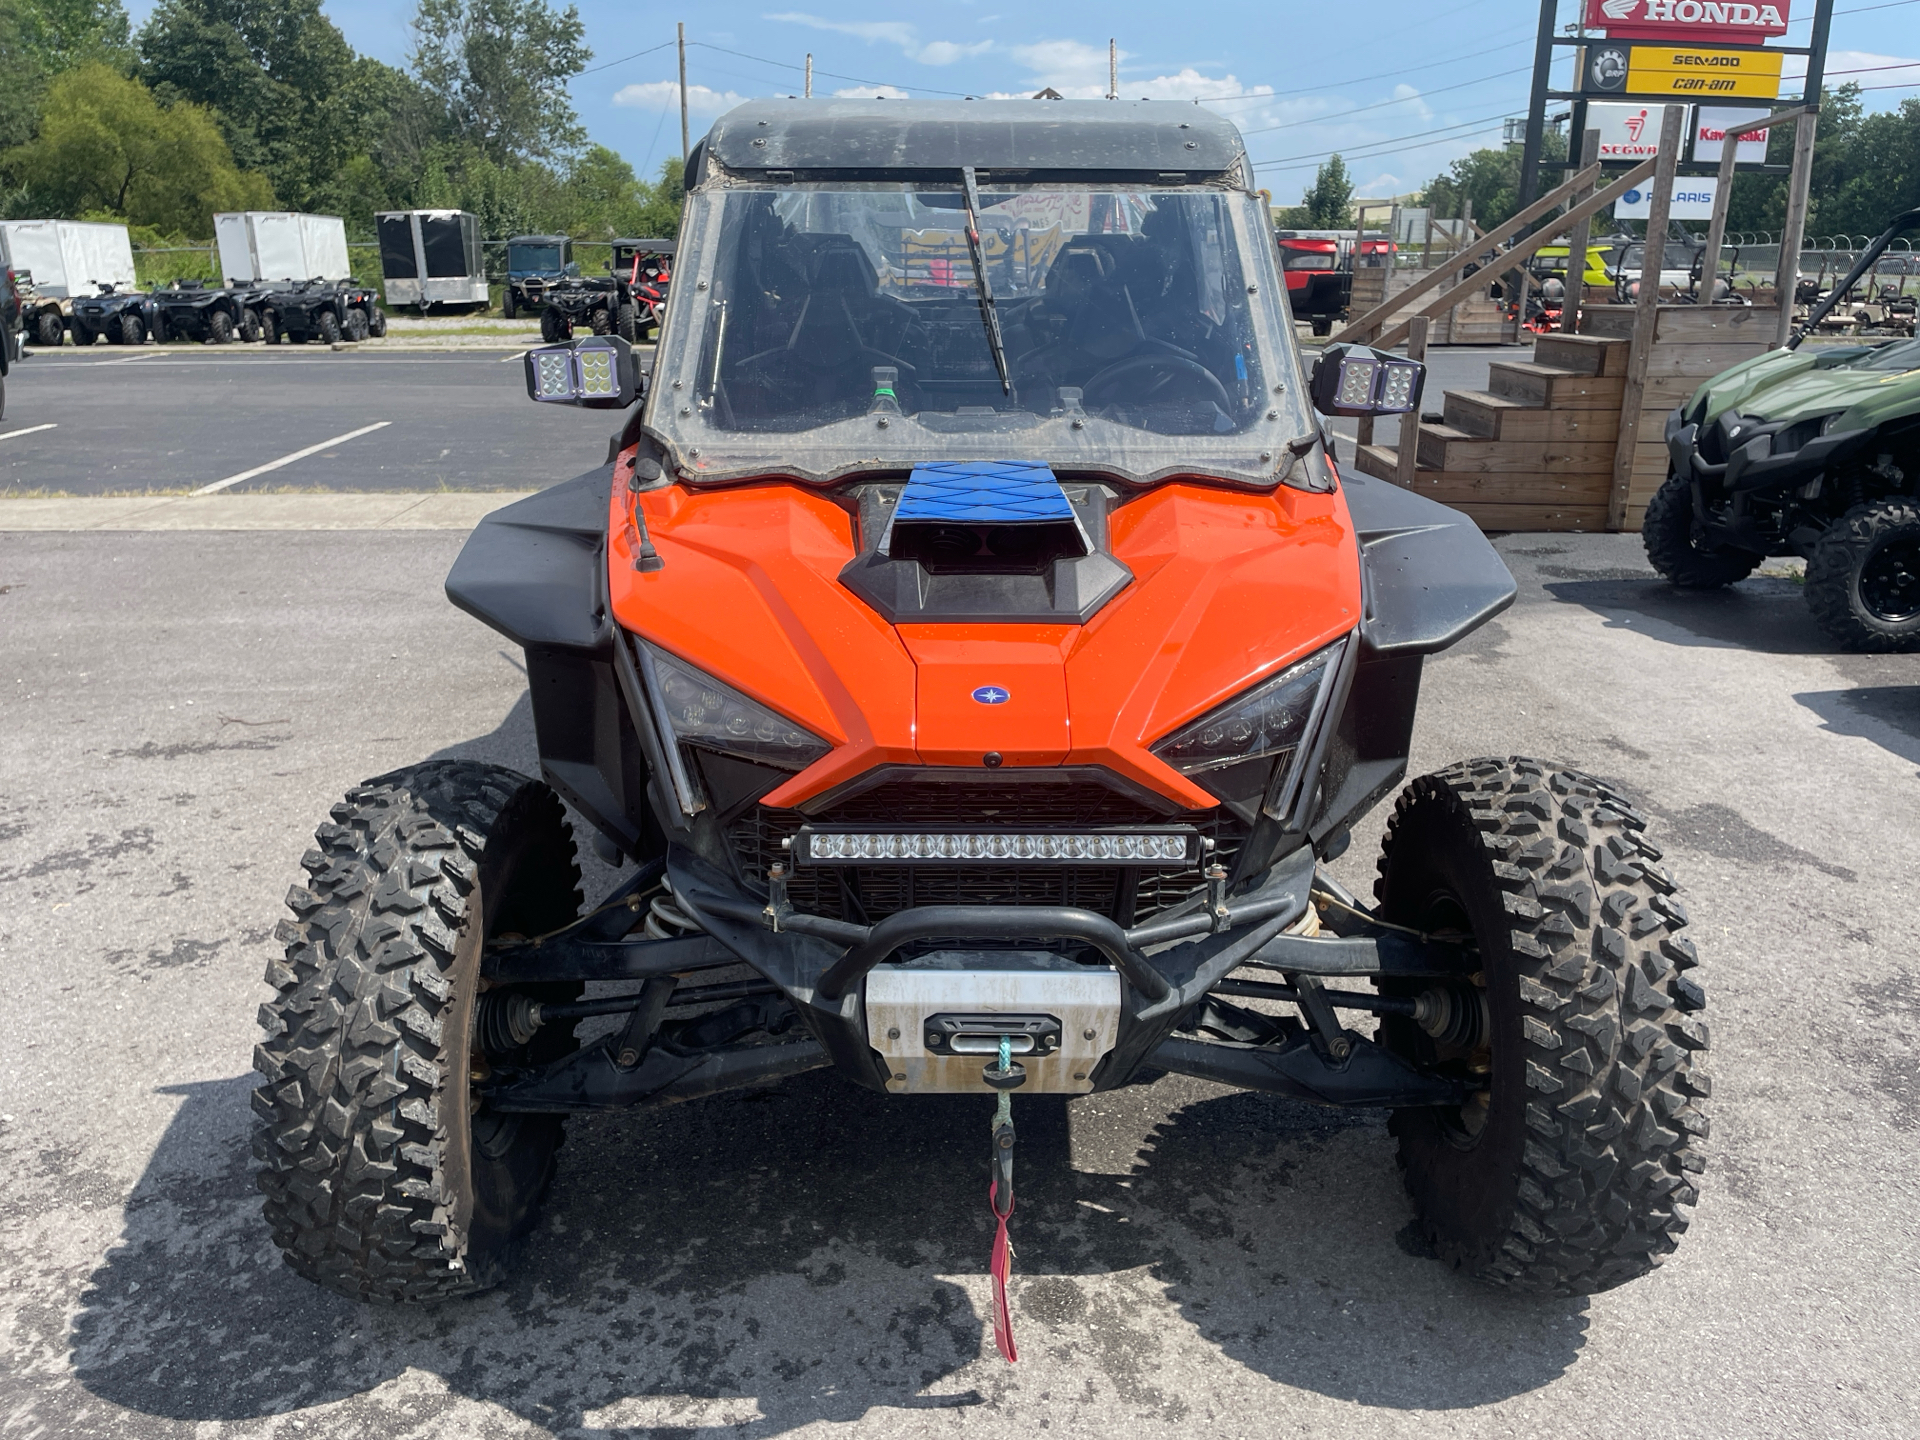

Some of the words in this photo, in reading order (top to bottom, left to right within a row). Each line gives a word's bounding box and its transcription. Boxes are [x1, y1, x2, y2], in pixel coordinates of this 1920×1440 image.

[1643, 0, 1785, 27] HONDA
[1605, 69, 1625, 78] BRP
[1601, 145, 1658, 155] SEGWA
